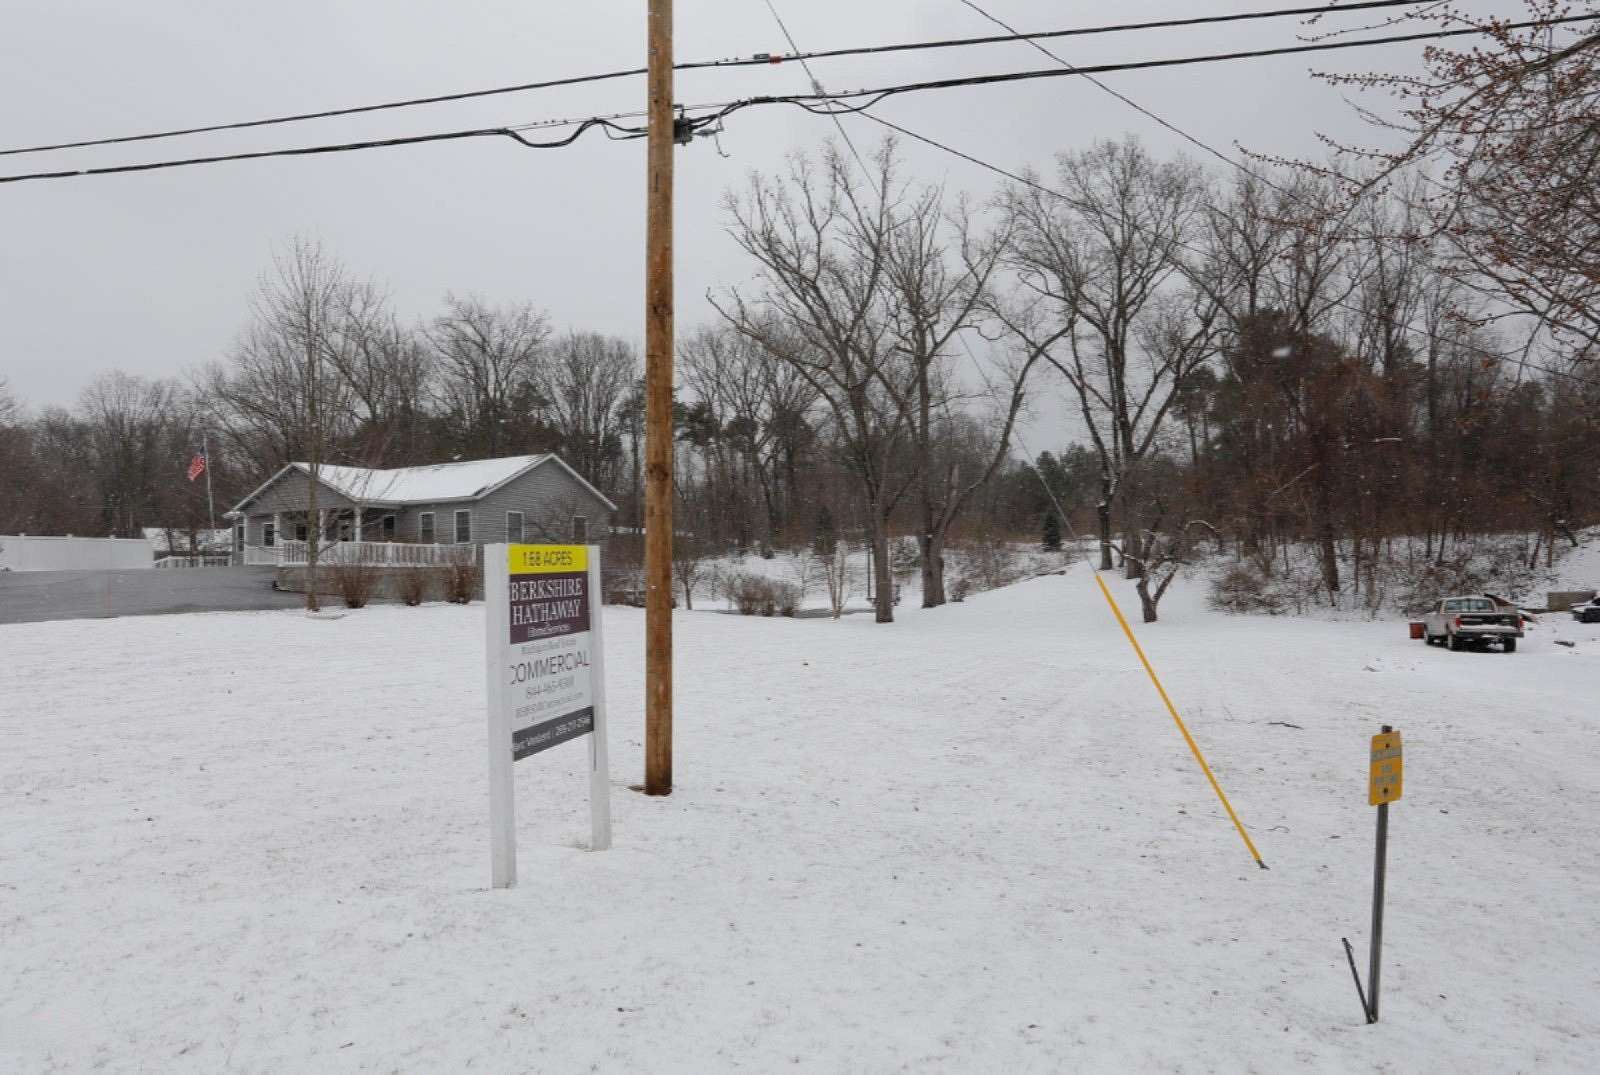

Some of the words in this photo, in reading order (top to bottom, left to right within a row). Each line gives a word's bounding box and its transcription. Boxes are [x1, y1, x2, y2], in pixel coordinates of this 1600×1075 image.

[544, 550, 572, 566] ACRES
[511, 578, 583, 601] BERKSHIRE
[512, 598, 581, 625] HATHAWAY
